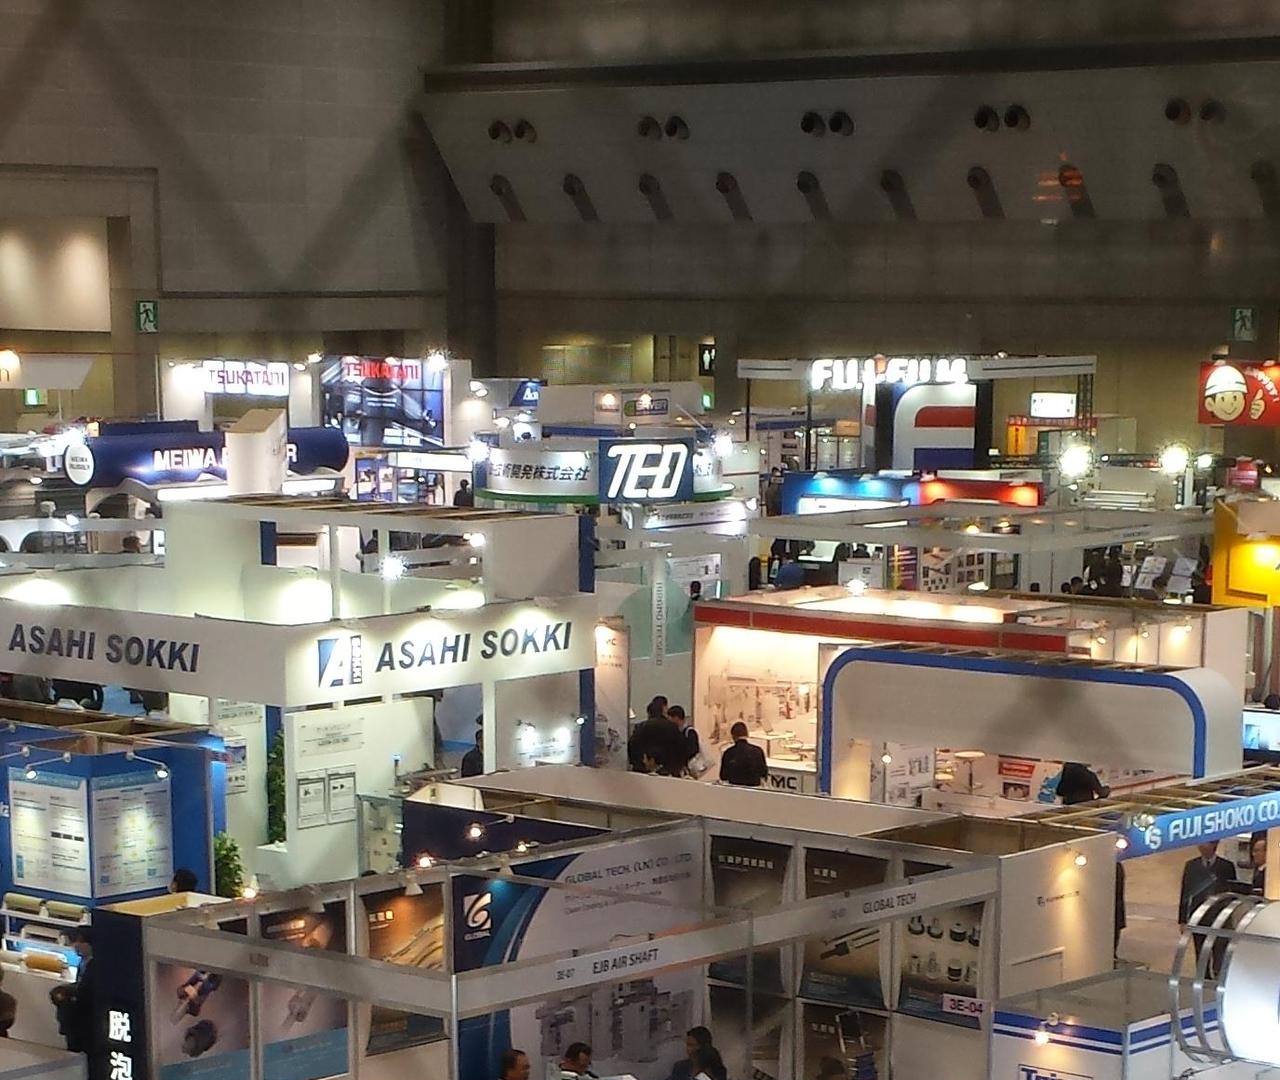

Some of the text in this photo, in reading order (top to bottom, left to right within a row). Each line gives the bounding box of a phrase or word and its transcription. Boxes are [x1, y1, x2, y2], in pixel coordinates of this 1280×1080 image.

[154, 447, 219, 471] MEIWA
[607, 443, 689, 499] TED
[9, 622, 201, 673] ASAHI SOKKI
[375, 621, 573, 673] ASAHI SOKKI
[1168, 819, 1203, 844] FUJI
[1204, 805, 1255, 837] SHOKO
[863, 891, 917, 915] GLOBAL TECH
[629, 948, 659, 968] SHAFT
[949, 997, 984, 1014] 3E-04
